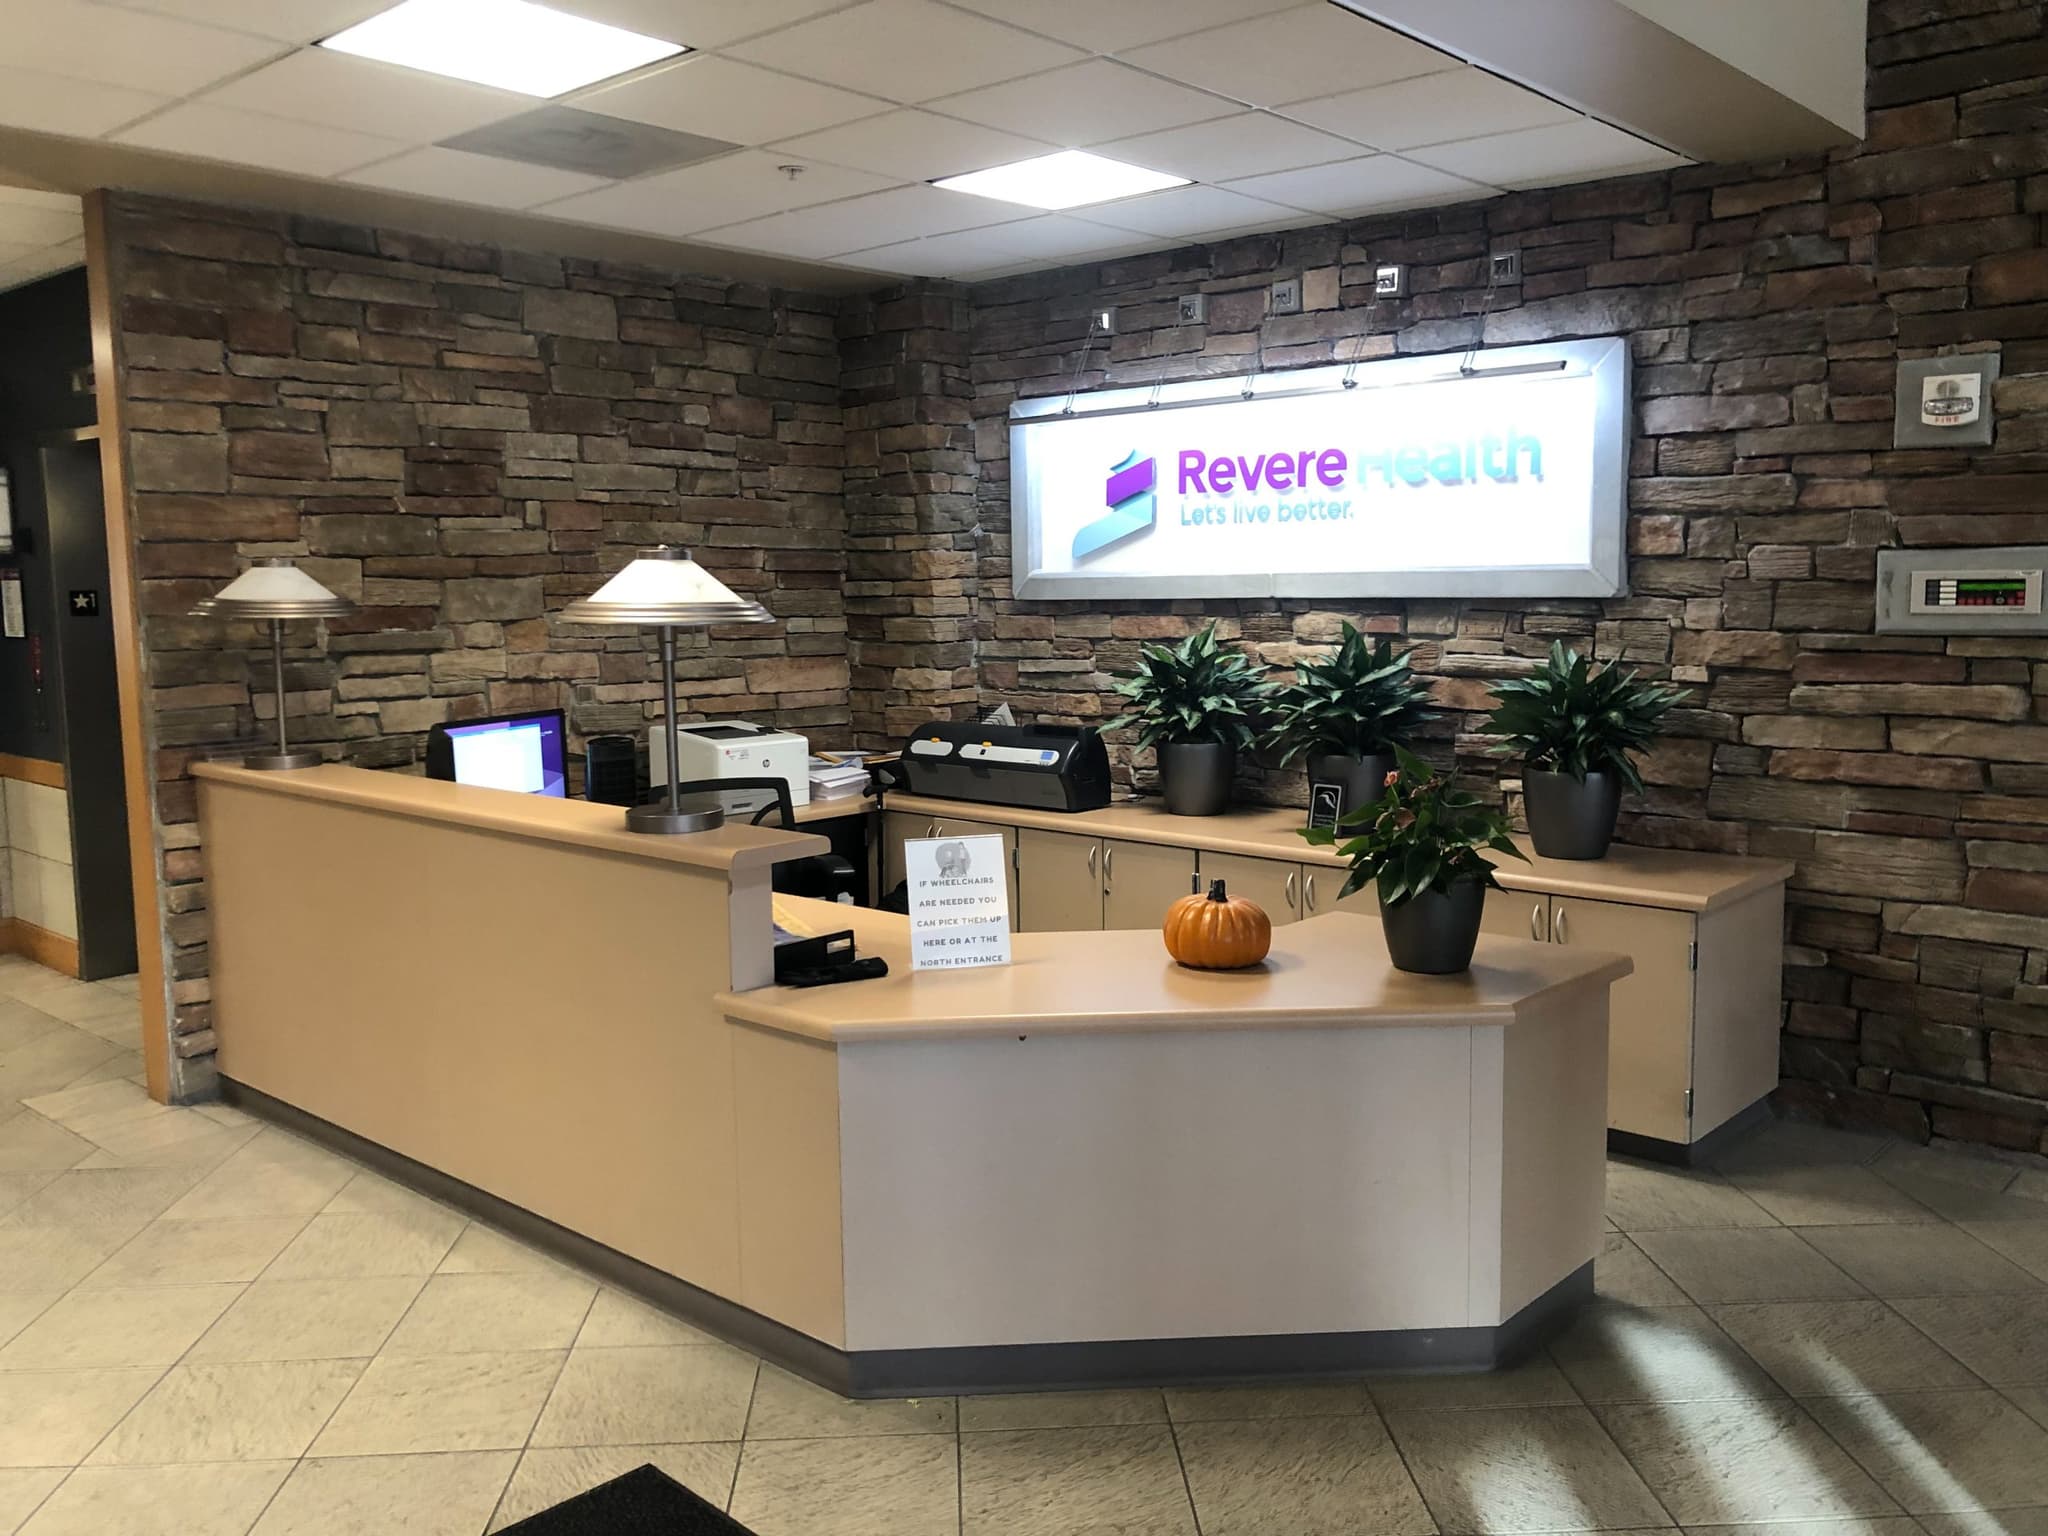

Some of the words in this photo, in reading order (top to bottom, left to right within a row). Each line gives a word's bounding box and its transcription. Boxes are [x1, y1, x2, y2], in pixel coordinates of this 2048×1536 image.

[1178, 448, 1347, 494] Revere
[1357, 426, 1543, 488] Health
[1181, 503, 1226, 526] Let's
[1233, 500, 1271, 524] live
[931, 877, 994, 886] WHEELCHAIRS
[939, 897, 976, 906] NEEDED
[978, 896, 997, 904] YOU
[917, 920, 936, 928] CAN
[939, 918, 959, 926] PICK
[962, 917, 987, 925] THEM
[923, 939, 946, 947] HERE
[964, 936, 977, 944] AT
[980, 935, 998, 943] THE
[920, 958, 952, 967] NORTH
[954, 955, 1003, 964] ENTRANCE
